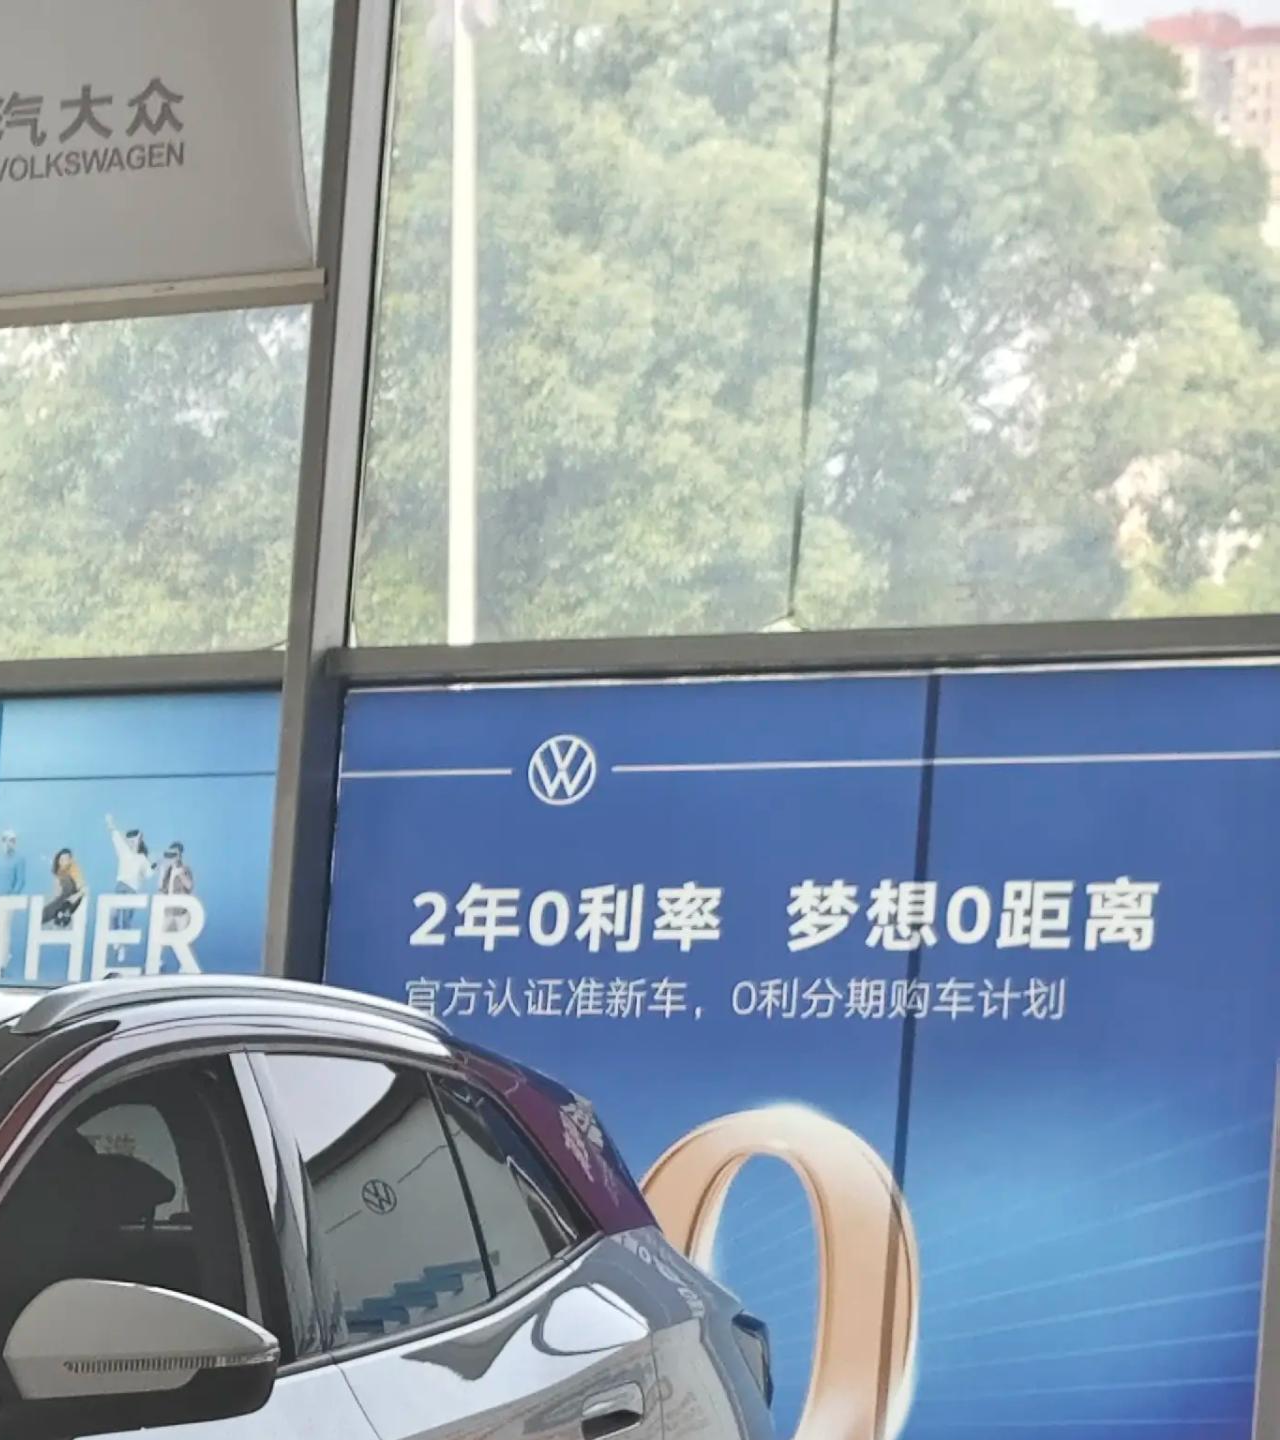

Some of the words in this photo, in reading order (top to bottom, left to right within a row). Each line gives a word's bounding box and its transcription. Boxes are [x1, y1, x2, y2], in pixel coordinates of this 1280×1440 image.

[408, 882, 723, 952] 2年0利率
[785, 876, 1162, 951] 梦想0距离
